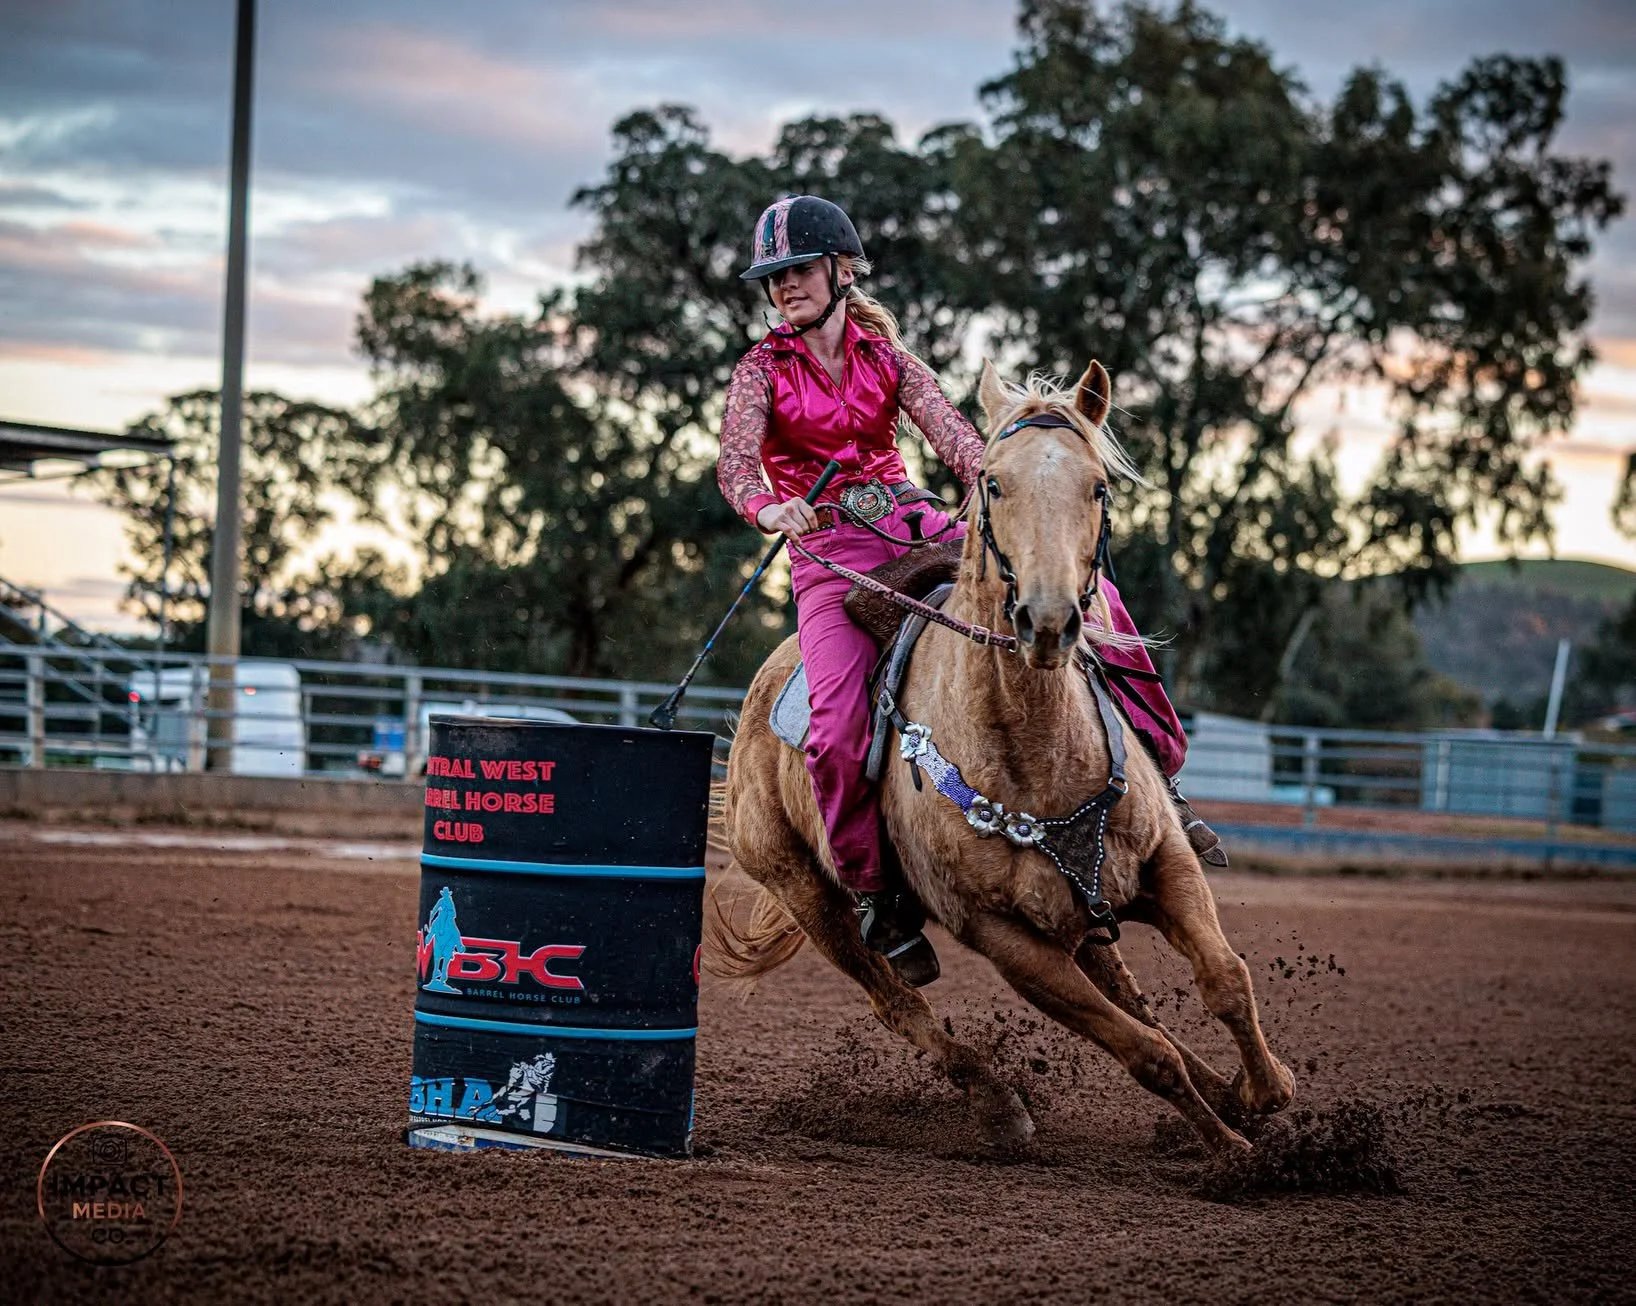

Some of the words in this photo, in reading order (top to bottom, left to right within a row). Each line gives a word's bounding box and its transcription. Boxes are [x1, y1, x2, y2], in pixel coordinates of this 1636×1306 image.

[480, 760, 556, 781] WEST
[465, 791, 555, 814] HORSE
[433, 820, 484, 843] CLUB
[467, 988, 505, 999] BARREL
[509, 992, 546, 1002] HORSE
[551, 995, 581, 1004] CLUB
